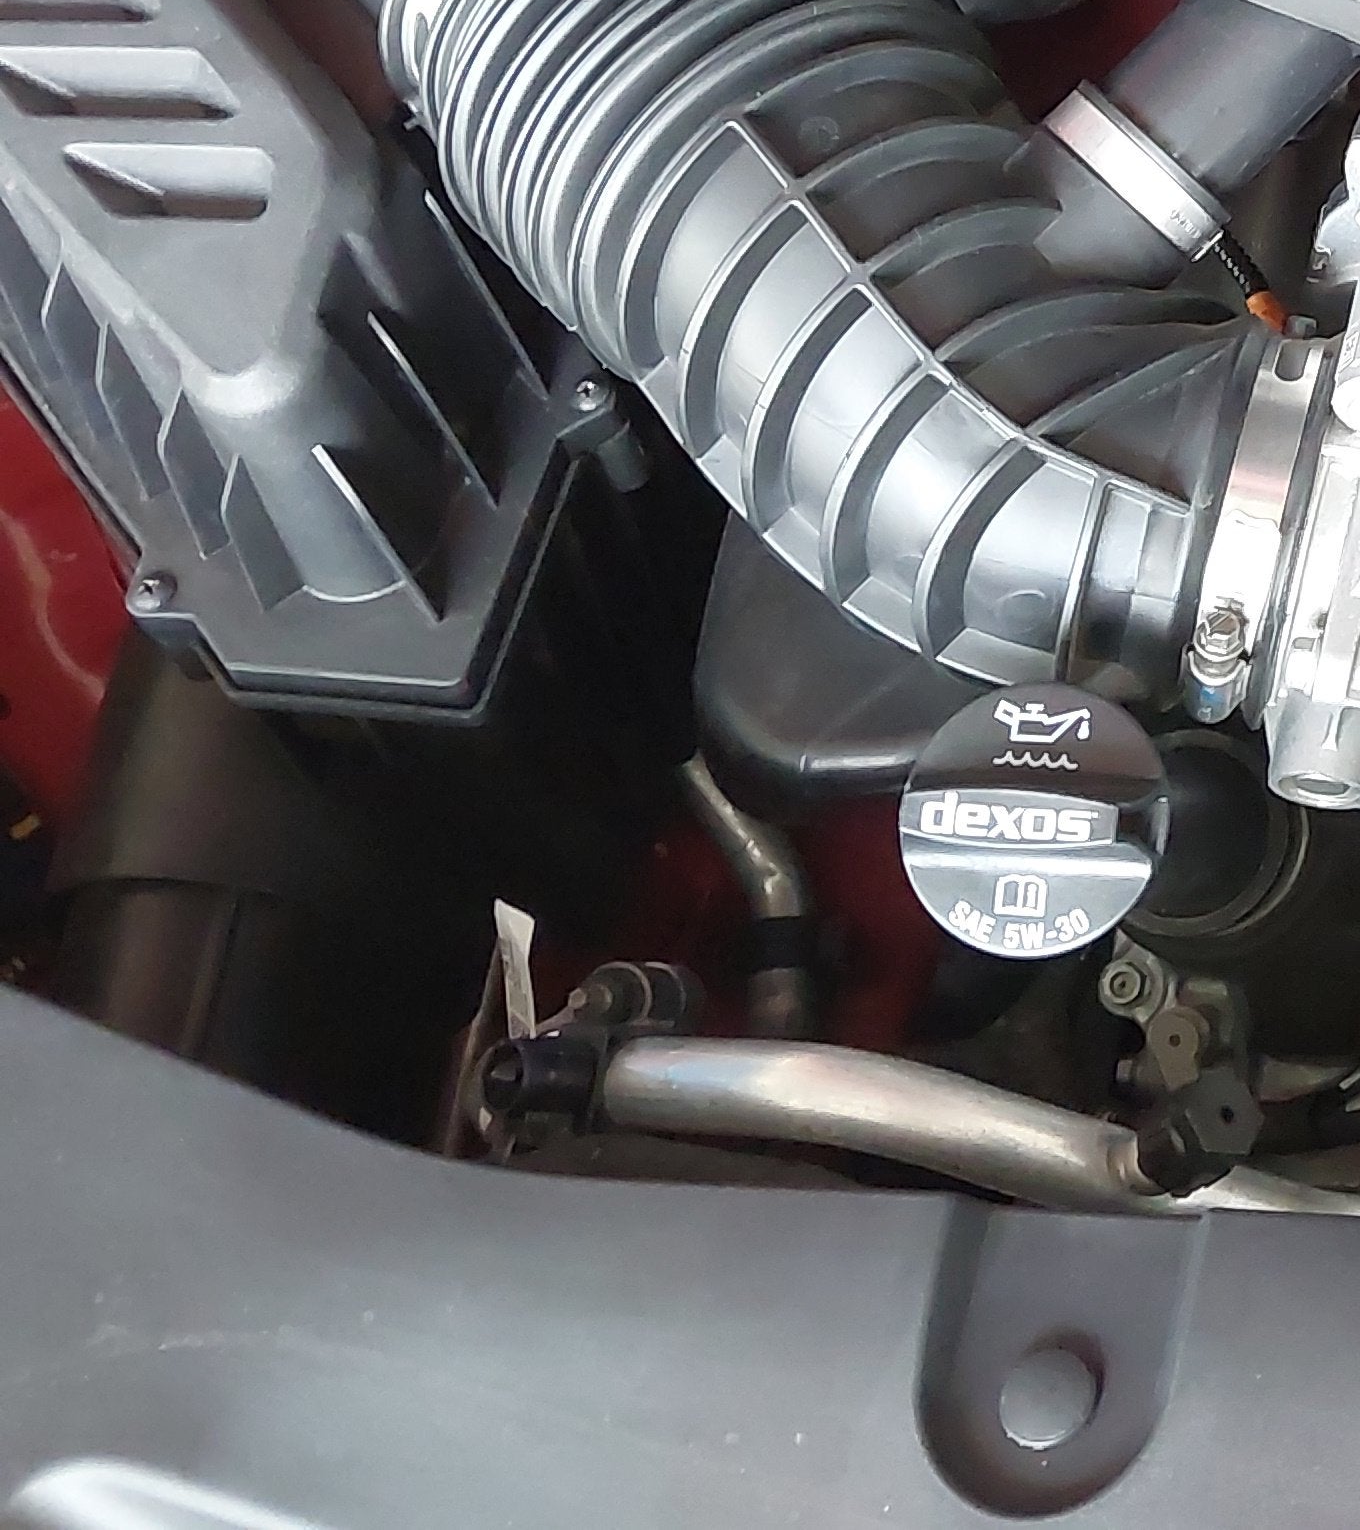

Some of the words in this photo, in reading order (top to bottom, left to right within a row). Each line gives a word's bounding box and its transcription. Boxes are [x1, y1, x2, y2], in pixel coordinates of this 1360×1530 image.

[920, 791, 1093, 842] dexos
[948, 899, 996, 943] SAE
[1001, 907, 1091, 950] 5W-30
